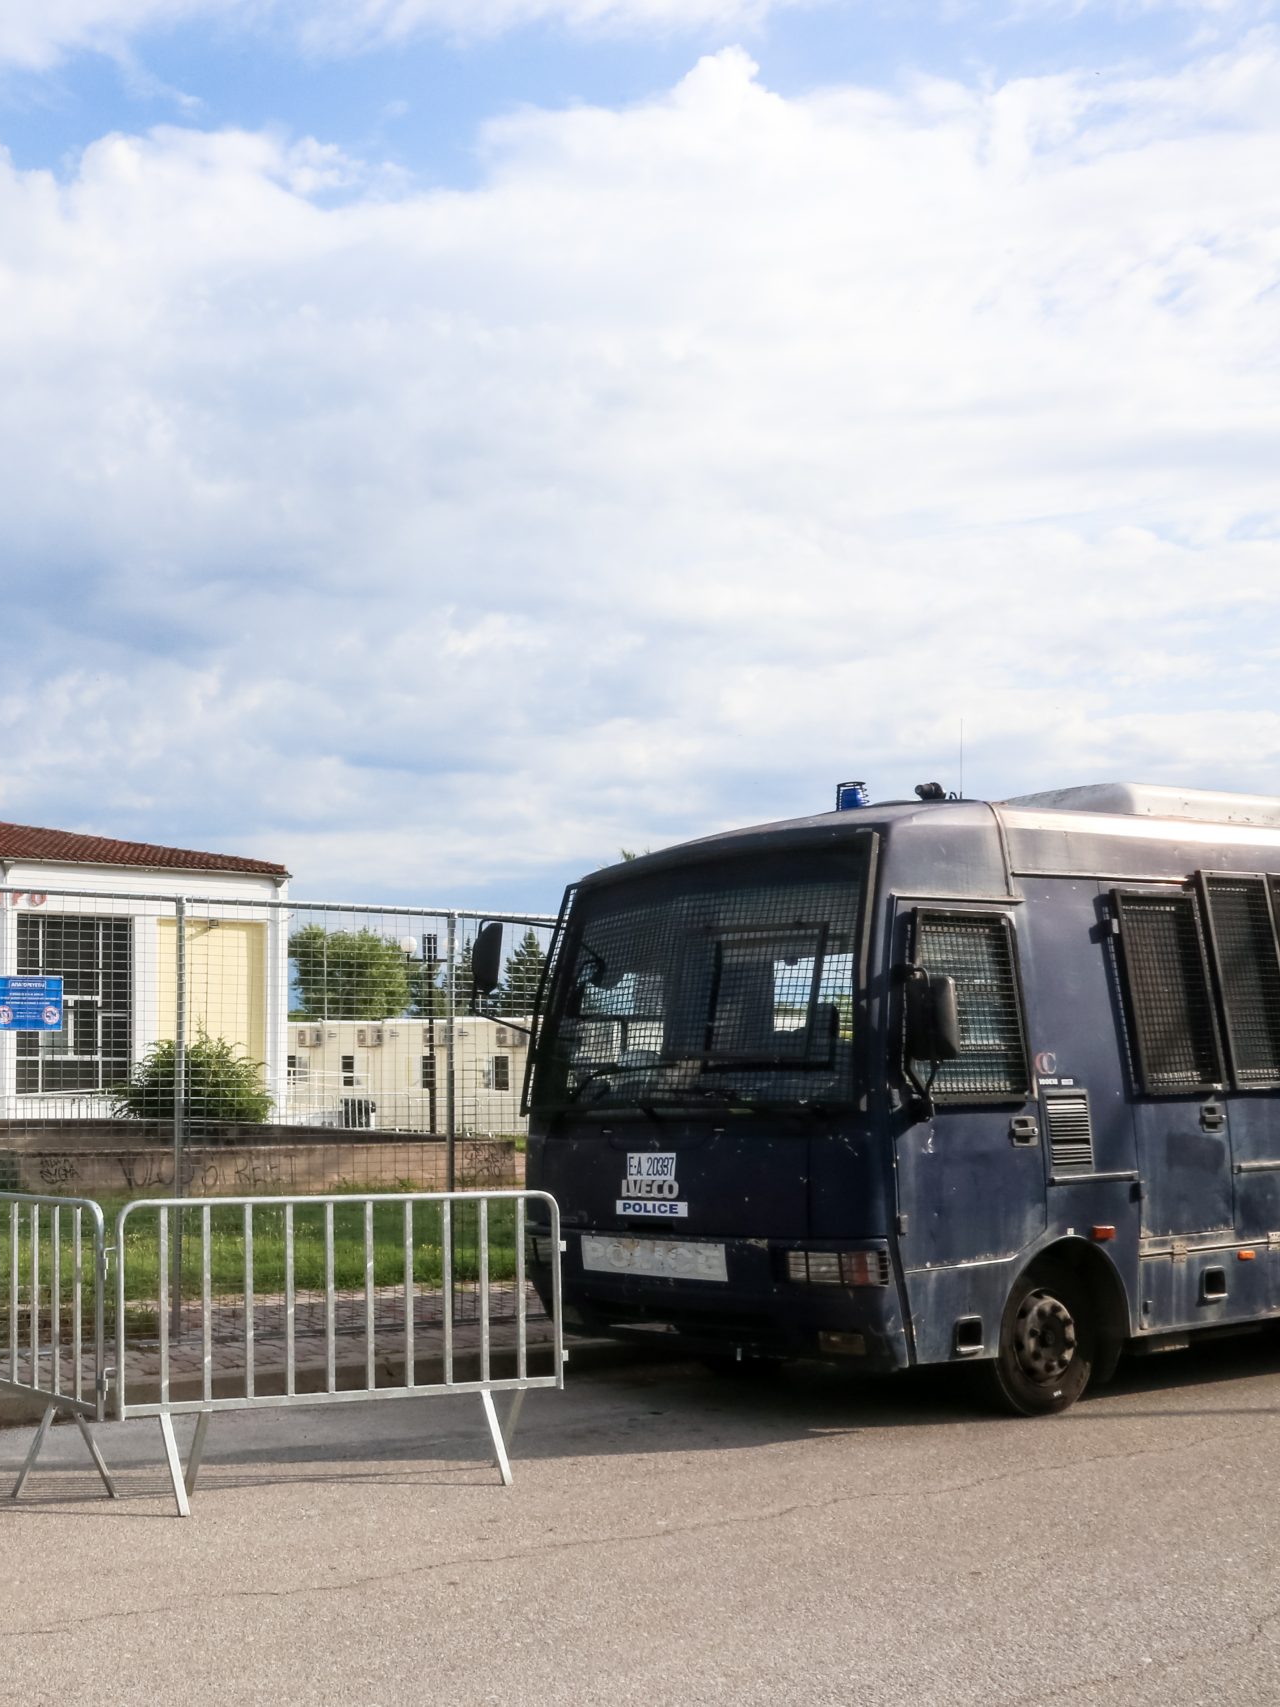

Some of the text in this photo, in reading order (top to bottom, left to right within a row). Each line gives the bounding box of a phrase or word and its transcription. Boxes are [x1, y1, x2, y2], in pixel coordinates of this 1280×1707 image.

[646, 1156, 675, 1177] 20337
[621, 1179, 679, 1199] IVECO
[622, 1202, 679, 1214] POLICE
